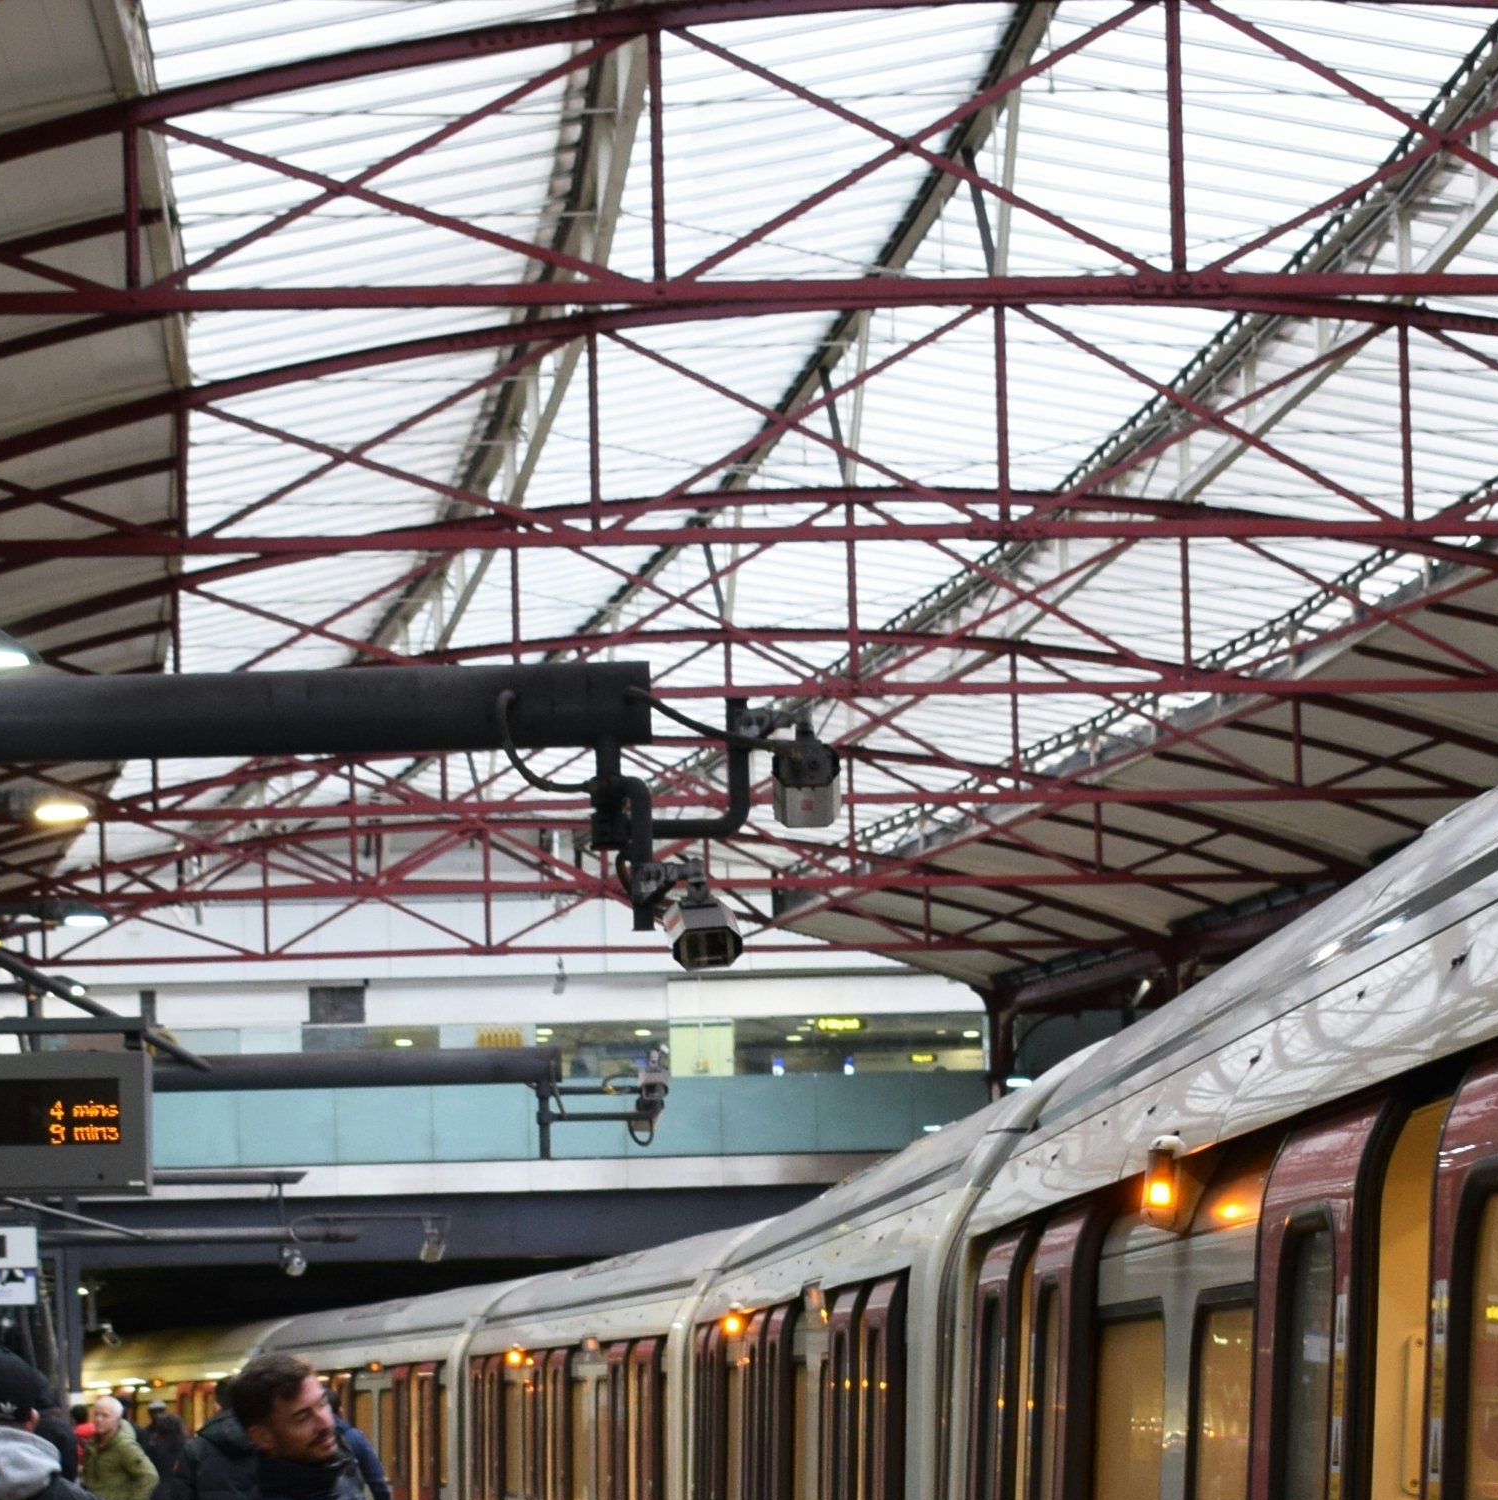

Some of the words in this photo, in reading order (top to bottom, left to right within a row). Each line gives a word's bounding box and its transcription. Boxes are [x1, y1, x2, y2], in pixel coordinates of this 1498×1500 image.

[49, 1100, 65, 1121] 4
[72, 1099, 119, 1117] mins
[73, 1123, 119, 1141] mins
